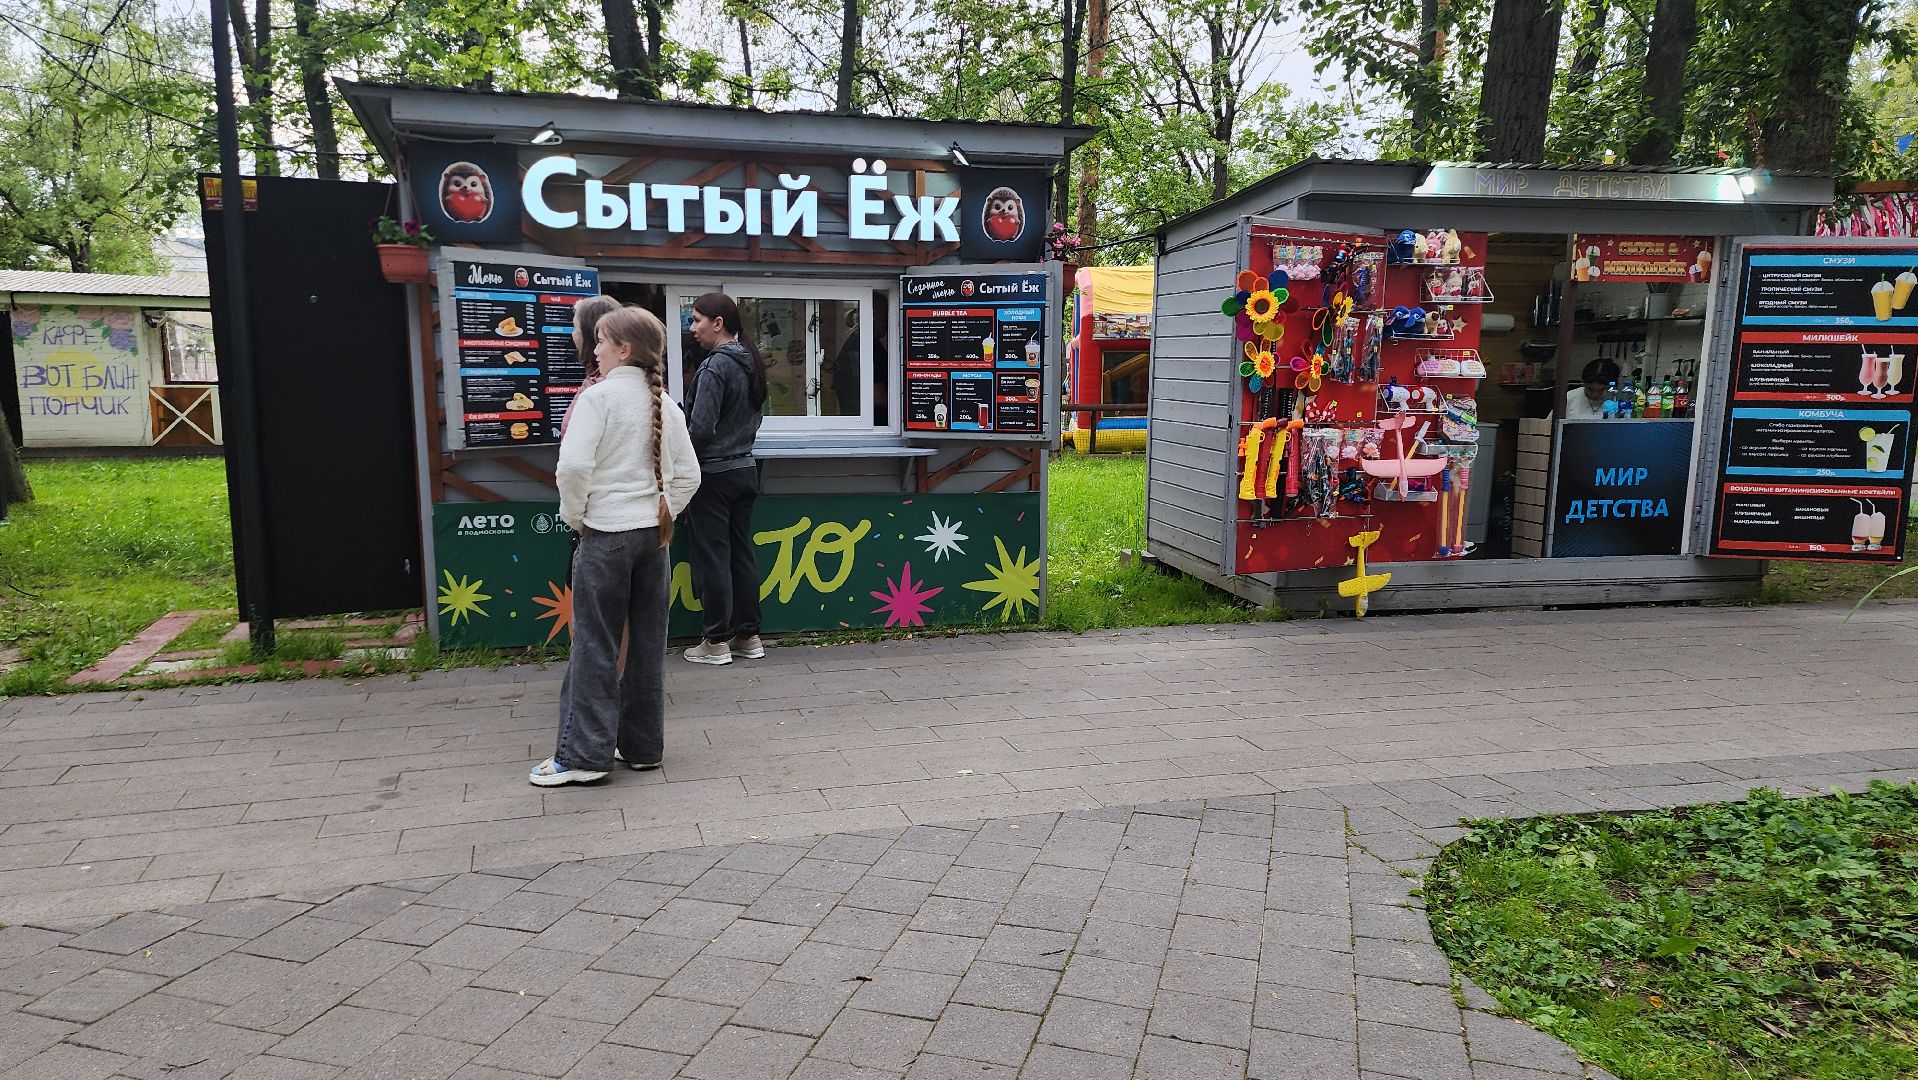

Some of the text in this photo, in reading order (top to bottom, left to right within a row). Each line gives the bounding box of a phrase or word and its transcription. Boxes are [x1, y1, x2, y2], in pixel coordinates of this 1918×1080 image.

[1475, 170, 1671, 200] МИР ДЕТСТВА
[521, 155, 960, 242] Сытый Ёж
[1823, 257, 1856, 265] СМУЗИ
[468, 264, 503, 285] Меню
[533, 272, 592, 288] Сытый Ёж
[979, 280, 1040, 294] Сытый Ёж
[43, 325, 98, 345] КАФЕ
[1802, 333, 1859, 342] МИЛКШЕЙК
[20, 363, 139, 390] ВОТ БЛИН
[29, 395, 131, 416] ПОНЧИК
[1799, 410, 1844, 418] КОМБУЧА
[1594, 467, 1648, 487] МИР
[1730, 485, 1896, 496] ВОЗДУШНЫЕ ВИТАМИНИЗИРОВАННЫЕ КОКТЕЙЛИ
[1565, 498, 1669, 524] ДЕТСТВА
